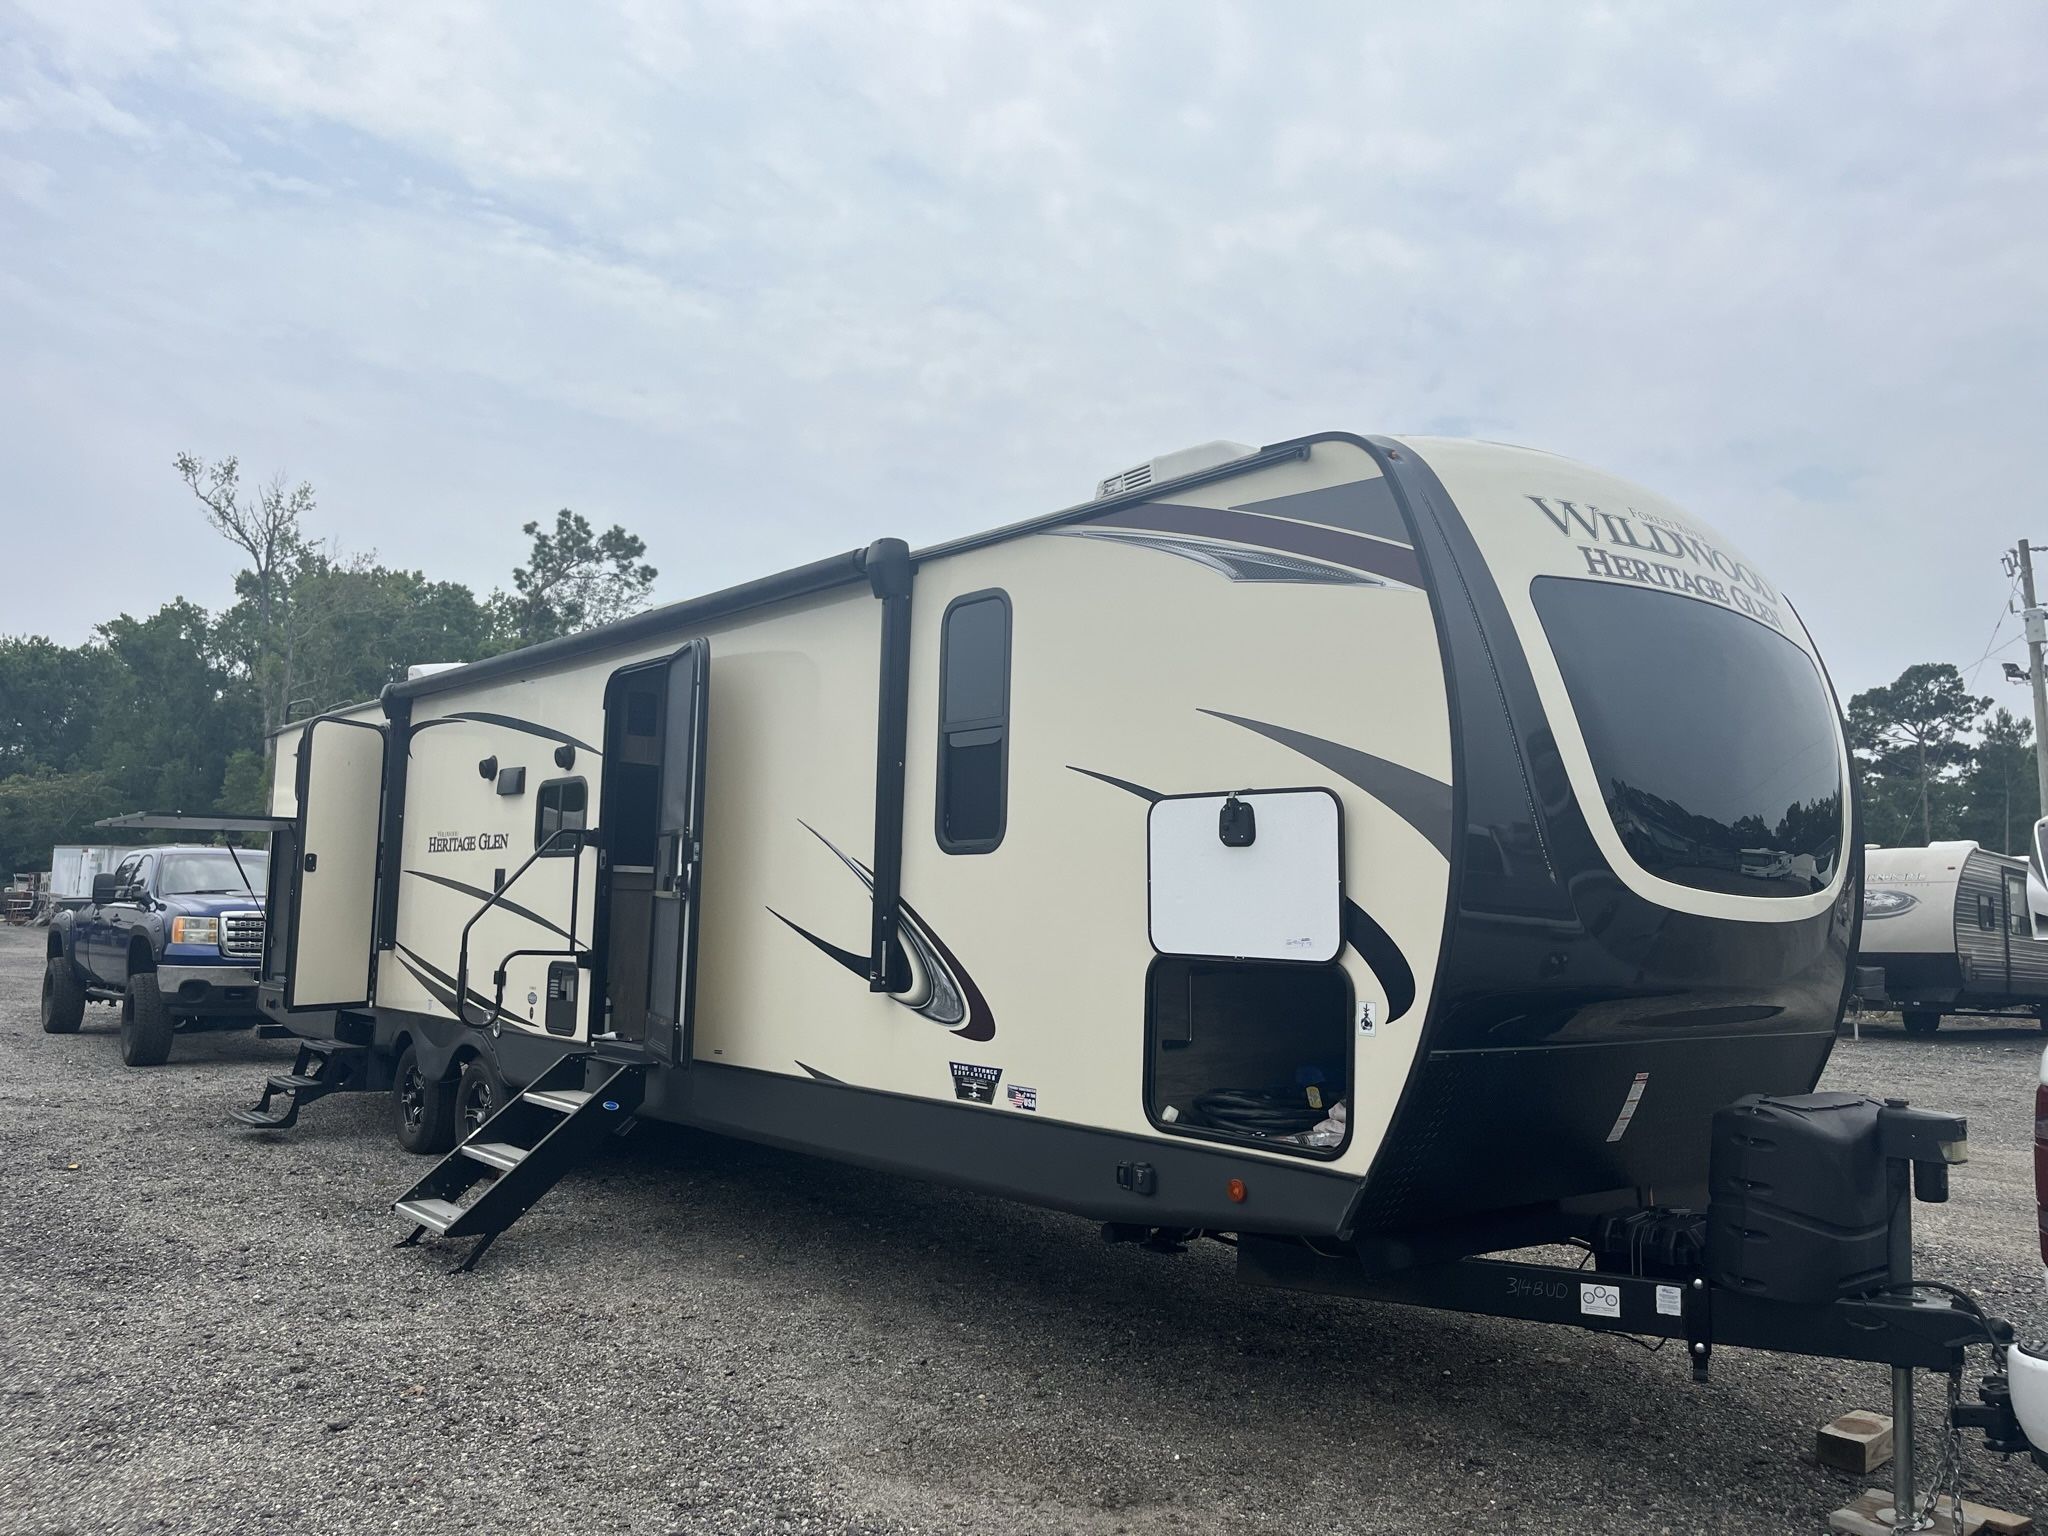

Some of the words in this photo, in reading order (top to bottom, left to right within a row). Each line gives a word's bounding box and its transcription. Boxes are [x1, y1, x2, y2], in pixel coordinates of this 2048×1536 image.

[1524, 494, 1777, 604] WILDWOOD
[1576, 545, 1731, 606] HERITAGE
[1729, 585, 1785, 631] GLEN
[428, 836, 476, 853] HERITAGE
[478, 833, 509, 850] GLEN
